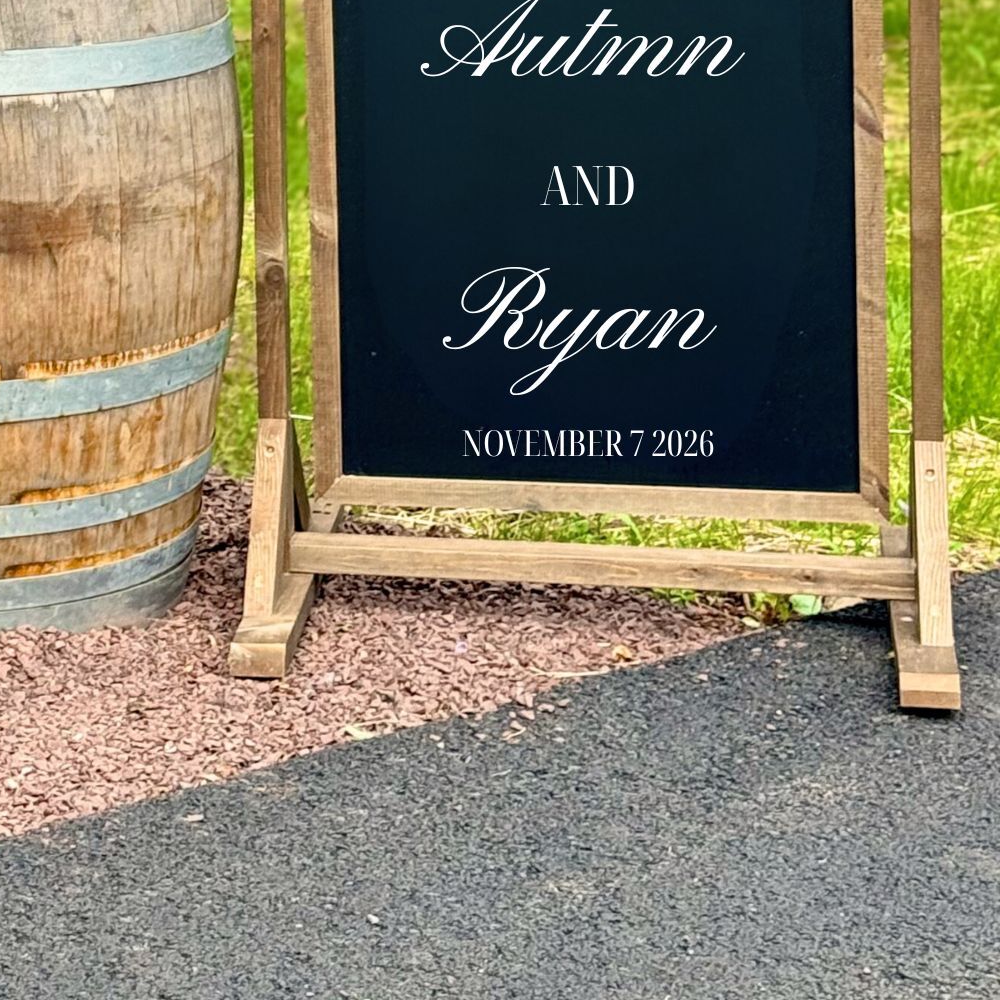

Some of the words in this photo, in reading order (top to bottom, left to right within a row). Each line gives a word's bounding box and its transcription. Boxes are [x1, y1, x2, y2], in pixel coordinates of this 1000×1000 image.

[540, 165, 635, 206] AND
[442, 266, 718, 396] Ryan
[461, 429, 624, 457] NOVEMBER
[629, 429, 645, 457] 7
[651, 429, 715, 457] 2026
